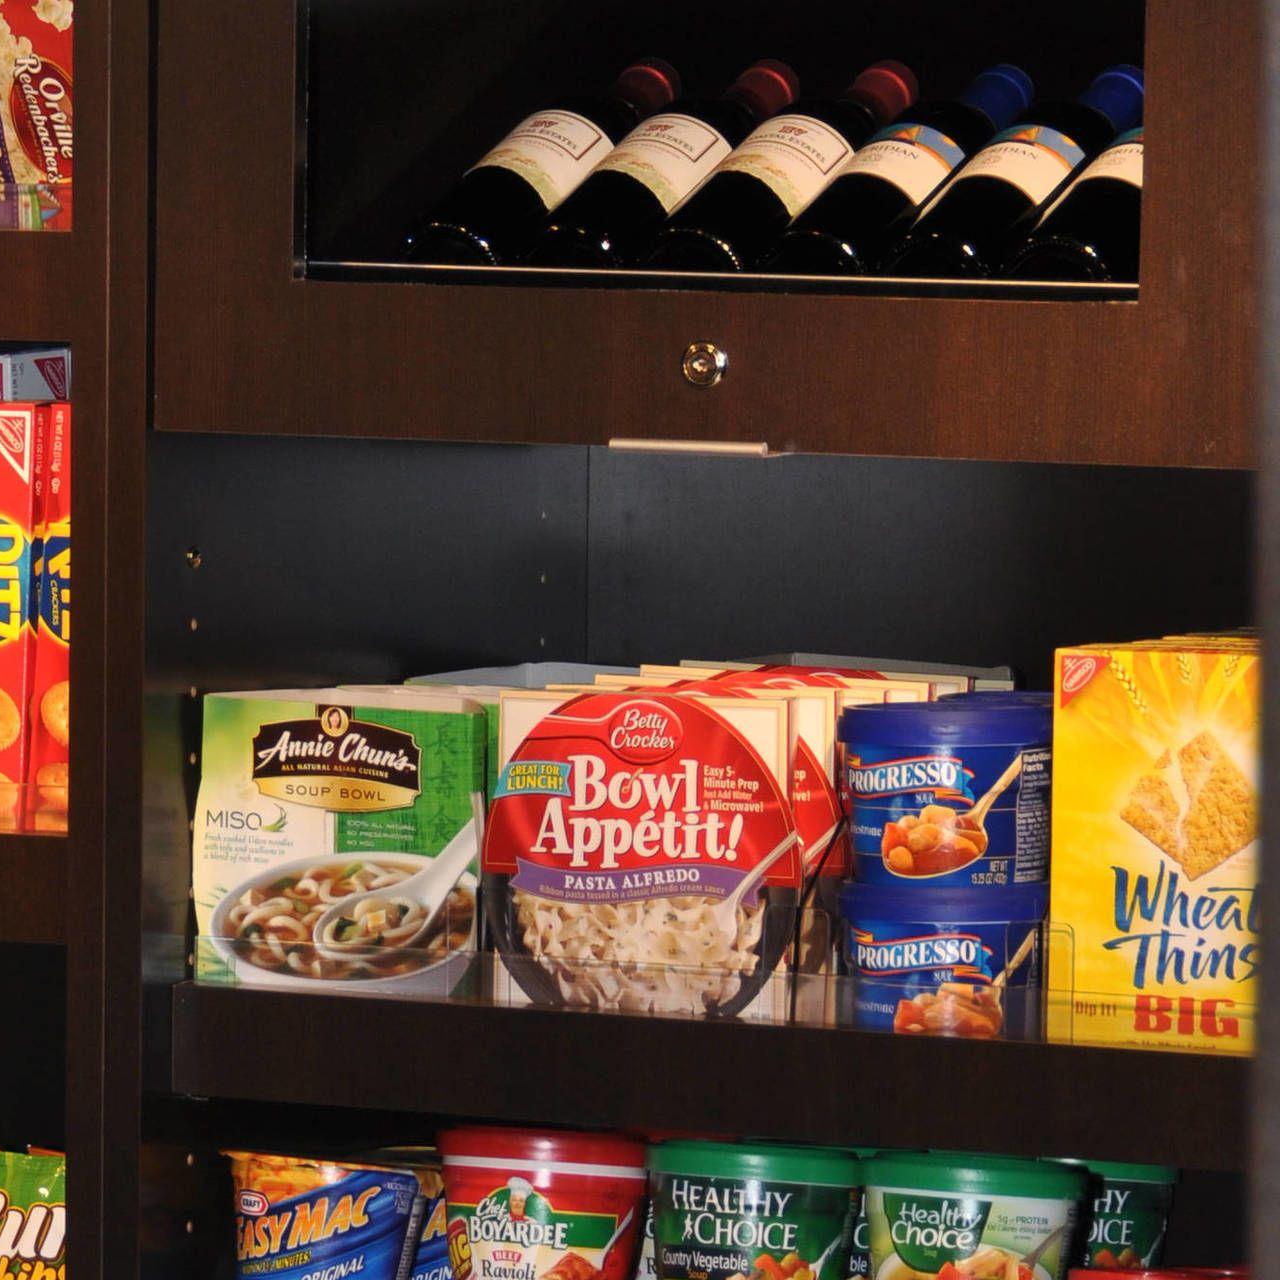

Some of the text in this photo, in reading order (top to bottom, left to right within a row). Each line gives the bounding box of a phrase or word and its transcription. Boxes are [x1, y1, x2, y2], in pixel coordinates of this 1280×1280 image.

[38, 76, 73, 160] Orville
[623, 709, 668, 736] Betty
[255, 731, 417, 771] Annie Chun's
[610, 727, 675, 750] Crocker
[297, 763, 331, 772] NATURAL
[333, 765, 356, 774] ASIAN
[358, 768, 389, 779] CUISINE
[507, 774, 564, 791] LUNCH!
[509, 765, 560, 776] GREAT FOR
[567, 754, 701, 813] Bowl
[704, 765, 725, 778] Easy
[849, 762, 956, 793] PROGRESSO
[286, 784, 386, 802] SOUP BOWL
[704, 778, 759, 792] Minute Prep
[710, 799, 764, 813] Microwave!
[206, 809, 262, 831] MISO
[530, 797, 744, 869] Appétit!
[564, 869, 700, 891] PASTA ALFREDO
[1110, 860, 1260, 933] Wheat
[856, 939, 977, 969] PROGRESSO
[1133, 993, 1240, 1038] BIG
[476, 1198, 507, 1219] Chef
[671, 1179, 793, 1218] HEALTHY
[287, 1186, 381, 1249] MAC
[899, 1199, 982, 1231] Healthy
[470, 1216, 568, 1250] BOYARDEE
[693, 1213, 799, 1250] CHOICE
[891, 1222, 974, 1250] Choice
[482, 1260, 537, 1280] Ravioli
[662, 1248, 749, 1272] Country Vegetable
